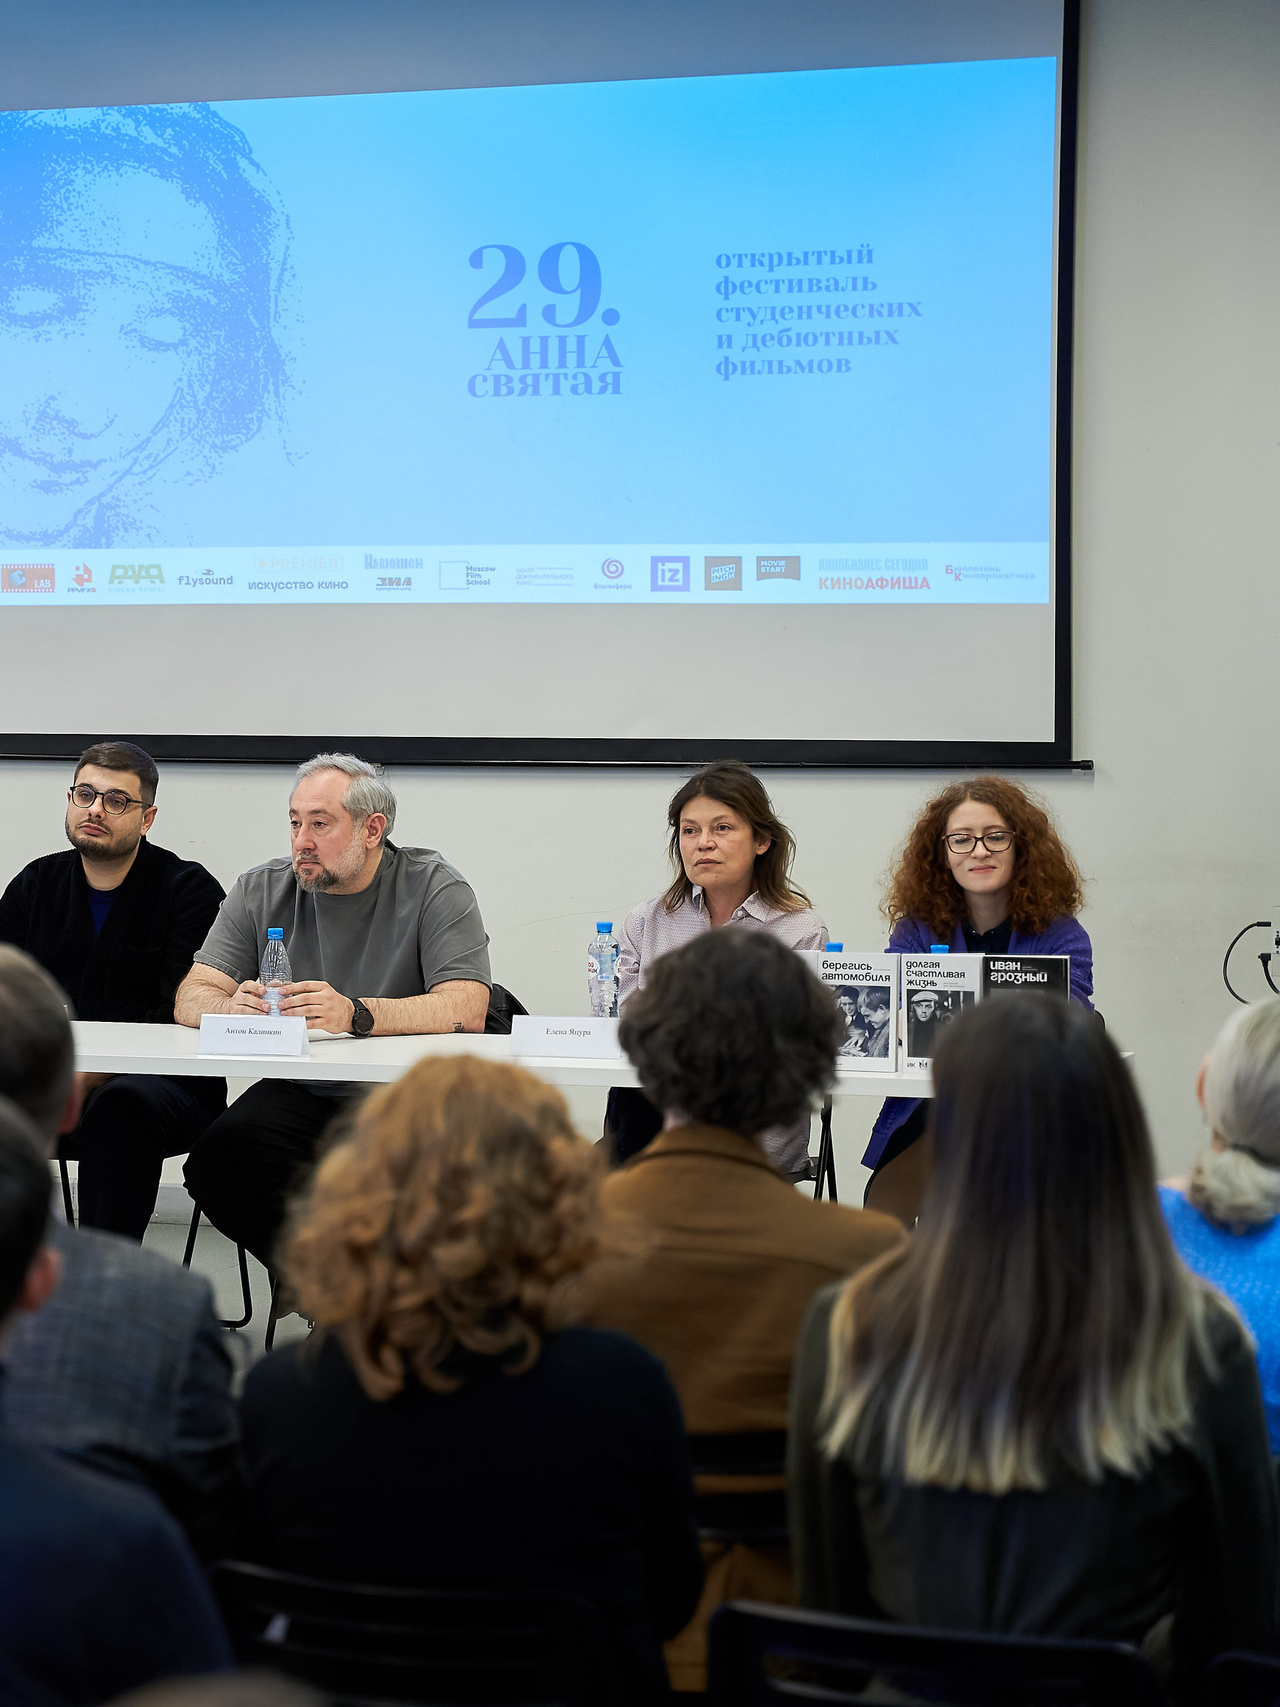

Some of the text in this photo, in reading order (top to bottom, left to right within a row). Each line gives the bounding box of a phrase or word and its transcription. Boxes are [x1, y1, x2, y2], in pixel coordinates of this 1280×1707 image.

[715, 243, 875, 272] открытый
[467, 241, 621, 329] 29.
[715, 273, 878, 301] фестиваль
[715, 301, 923, 328] студенческих
[716, 327, 901, 353] и дебютных
[484, 333, 625, 371] АННА
[715, 356, 852, 381] фильмов
[270, 557, 339, 571] PREMIER
[466, 565, 496, 573] Moscow
[712, 565, 735, 575] PITCH
[818, 558, 928, 572] КИНОБИЗНЕС СЕГОДНЯ
[661, 562, 680, 582] iz
[34, 579, 51, 588] LAB
[177, 576, 234, 588] flysound
[818, 576, 932, 590] КИНОАФИША
[821, 960, 873, 971] берегись
[905, 960, 940, 969] долгая
[989, 961, 1020, 971] иван
[821, 972, 891, 982] автомобиля
[905, 970, 966, 979] счастливая
[990, 971, 1048, 985] грозный
[906, 979, 938, 989] жизнь
[546, 1028, 567, 1036] Елена
